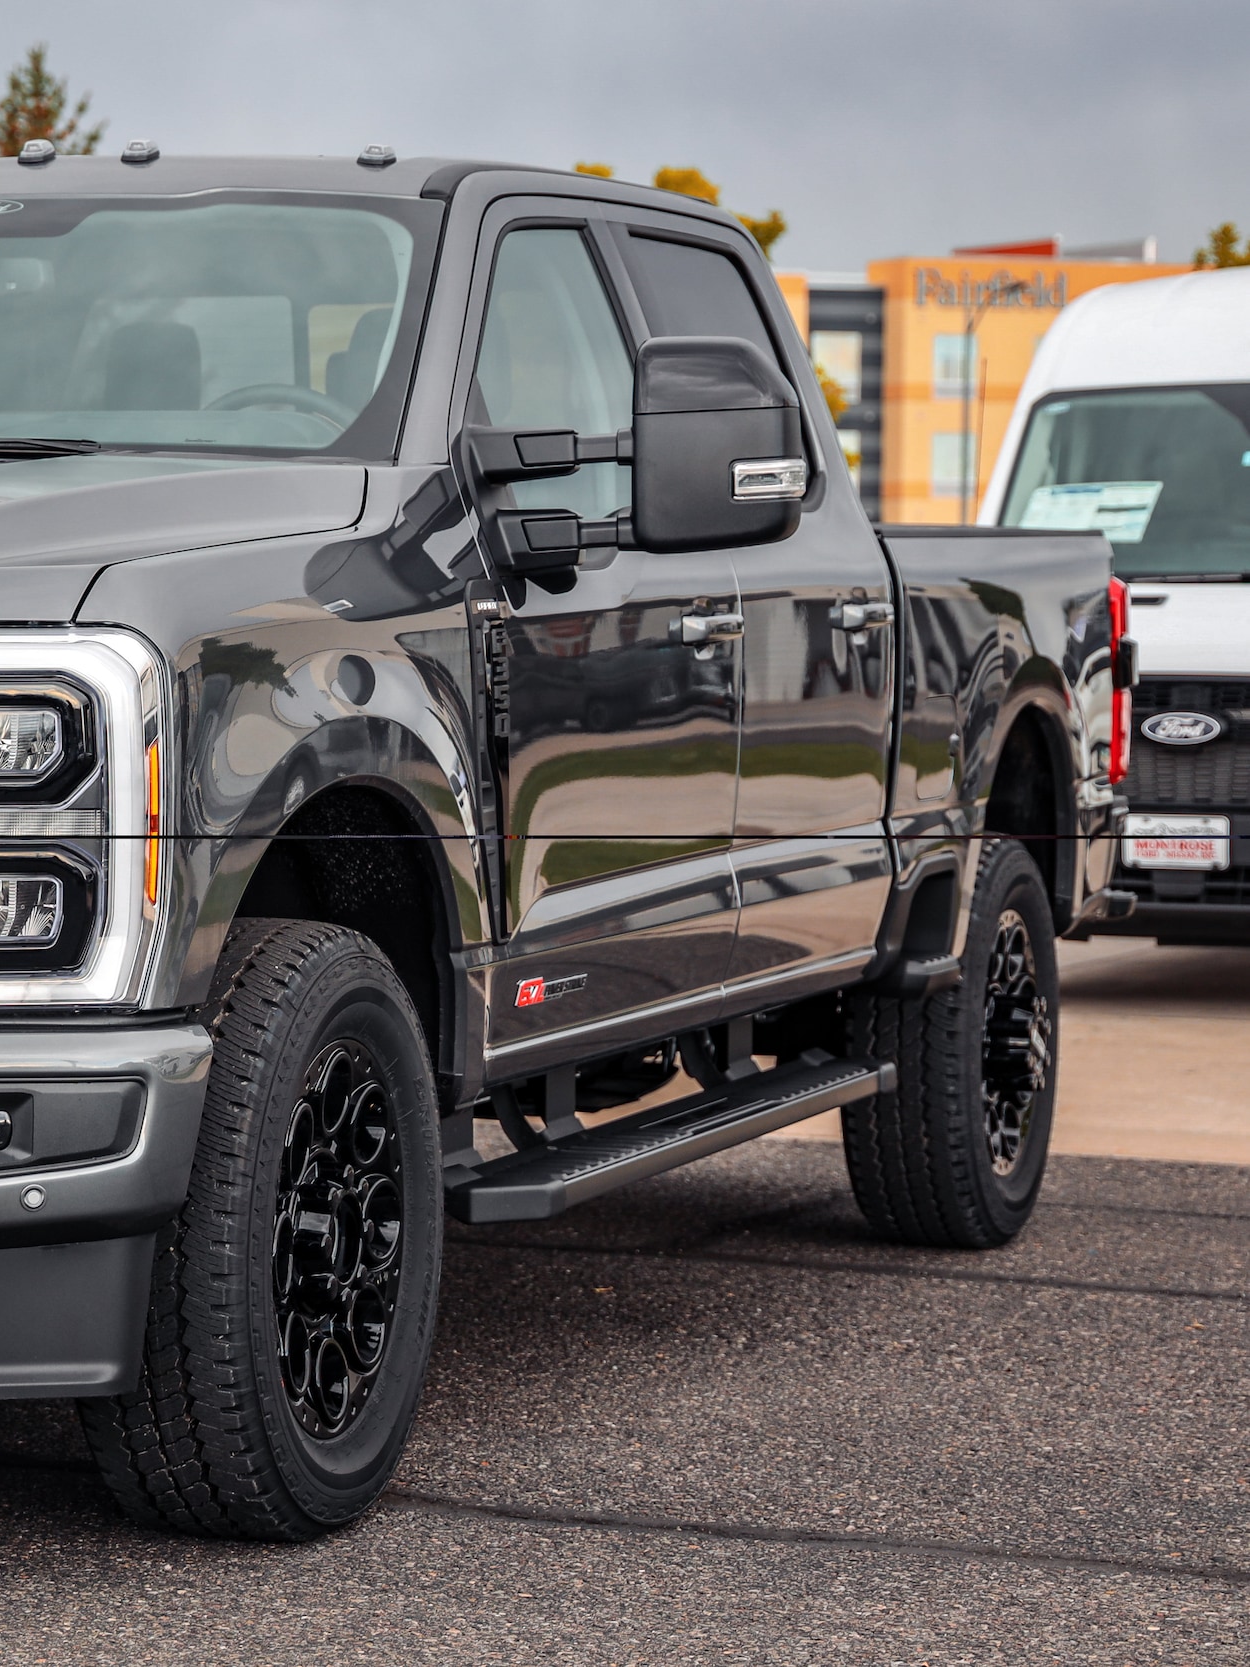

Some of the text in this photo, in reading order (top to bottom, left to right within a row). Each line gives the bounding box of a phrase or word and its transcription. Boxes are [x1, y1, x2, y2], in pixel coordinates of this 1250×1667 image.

[916, 267, 1069, 307] Fairfield
[1155, 717, 1206, 738] Ford
[1135, 840, 1215, 851] MONTROSE
